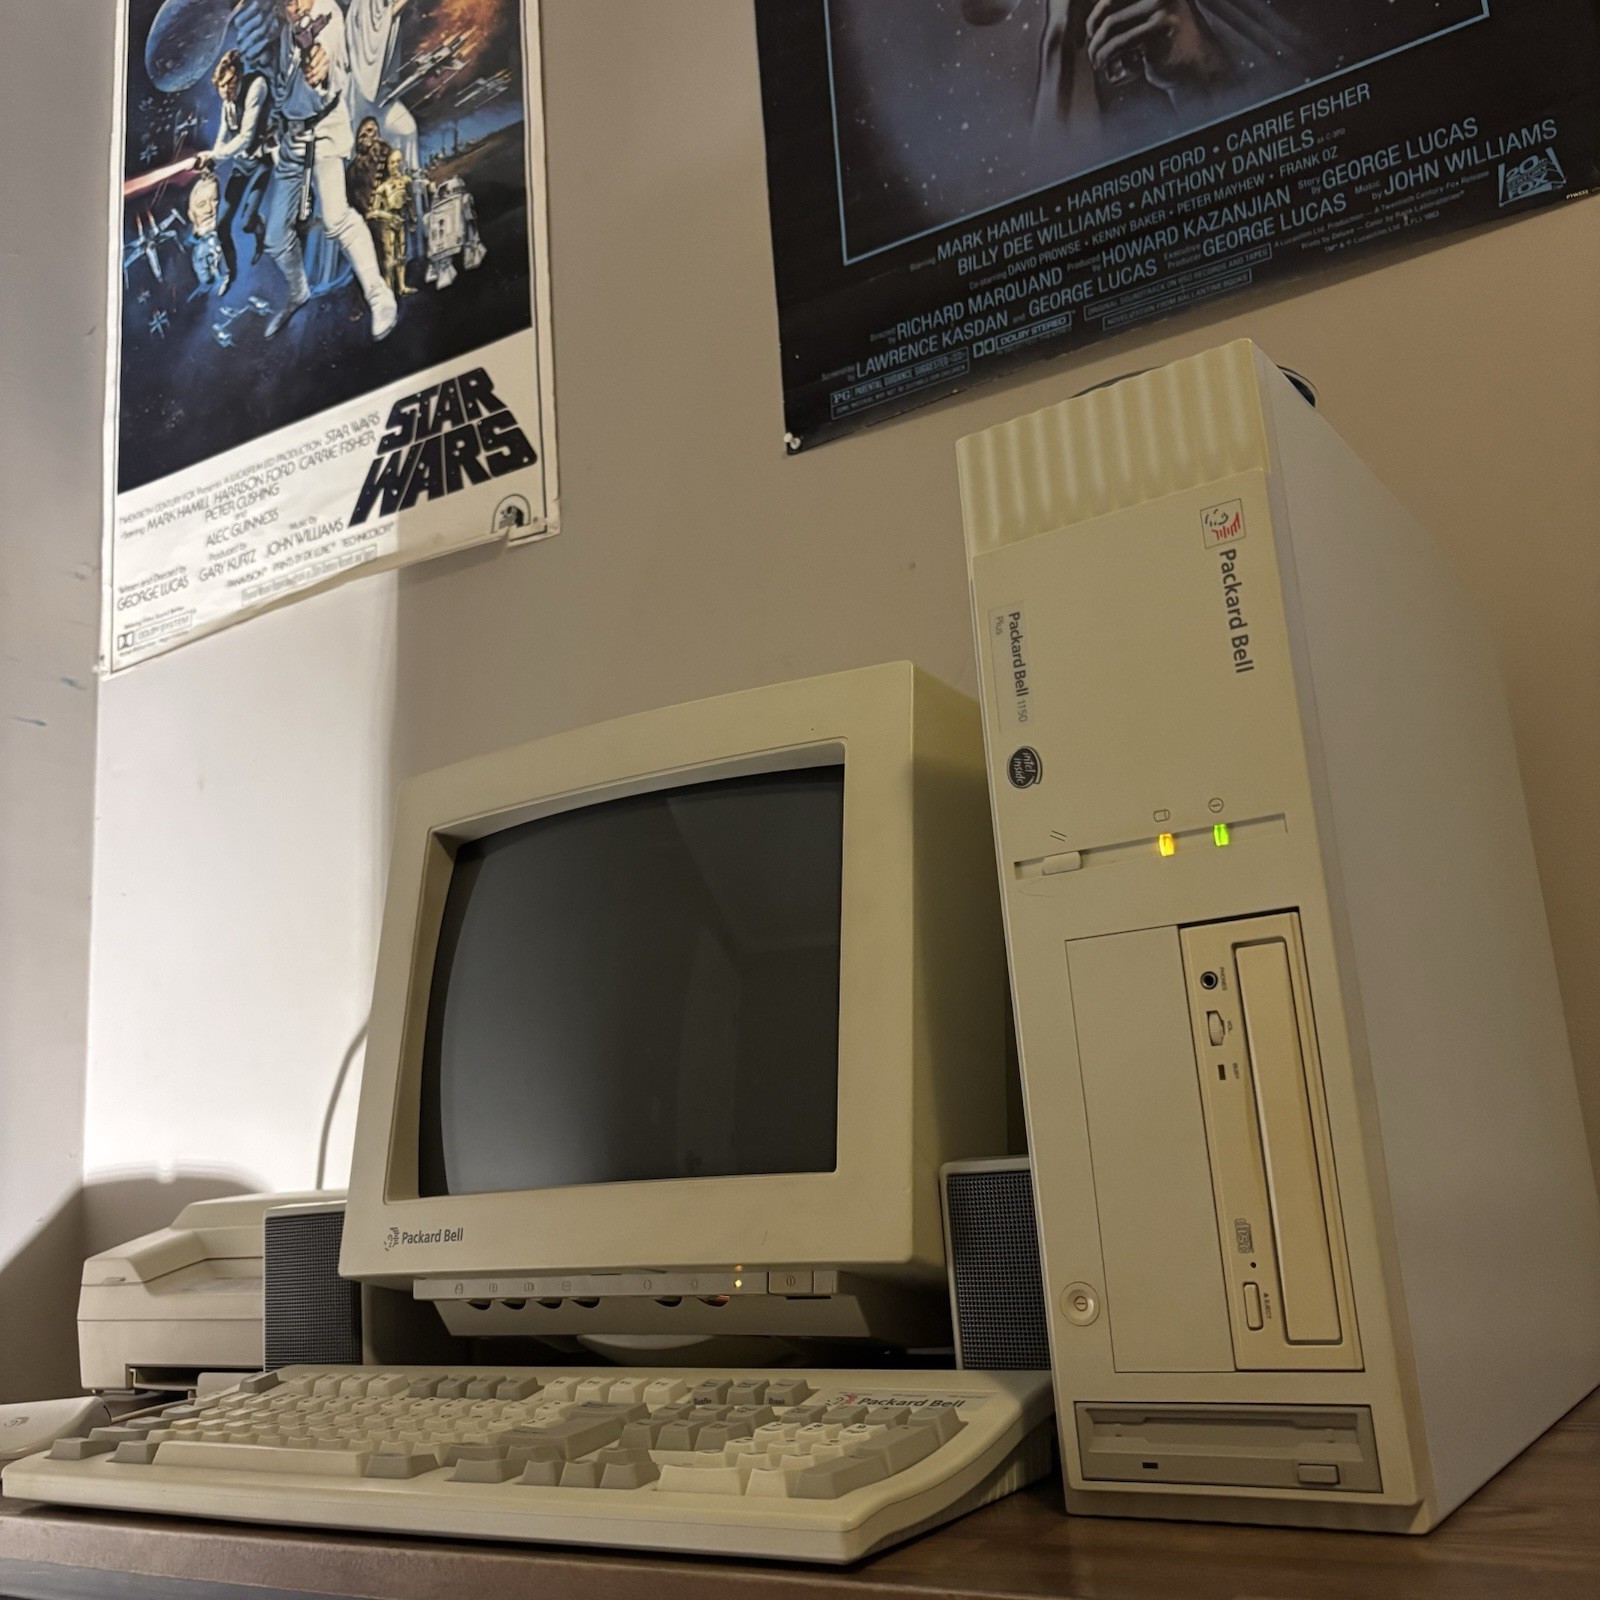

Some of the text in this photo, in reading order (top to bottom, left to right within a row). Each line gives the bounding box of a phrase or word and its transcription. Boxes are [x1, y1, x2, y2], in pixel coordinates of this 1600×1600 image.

[937, 230, 983, 261] MARK
[987, 207, 1049, 242] HAMILL
[1067, 165, 1155, 212] HARRISON
[1159, 146, 1206, 177] FORD
[1226, 111, 1295, 151] CARRIE
[1300, 83, 1370, 123] FISHER
[1509, 173, 1549, 198] FOX
[957, 246, 999, 276] BILLY
[1003, 234, 1033, 259] DEE
[1037, 201, 1123, 246] WILLIAMS
[1141, 161, 1226, 209] ANTHONY
[1232, 129, 1315, 175] DANIELS
[1008, 257, 1037, 276] DAVID
[1039, 241, 1081, 265] PROWSE
[1091, 224, 1126, 246] KENNY
[1130, 210, 1166, 231] BAKER
[1177, 195, 1211, 215] PETER
[1214, 173, 1265, 201] MAYHEW
[1279, 154, 1320, 178] FRANK
[1322, 146, 1338, 162] OZ
[856, 335, 939, 378] LAWRENCE
[942, 311, 1008, 348] KASDAN
[1029, 280, 1094, 317] GEORGE
[1098, 258, 1157, 293] LUCAS
[1202, 217, 1276, 257] GEORGE
[1280, 192, 1347, 231] LUCAS
[1354, 180, 1381, 194] Music
[1371, 191, 1383, 200] by
[1385, 159, 1440, 196] JOHN
[1444, 119, 1558, 174] WILLIAMS
[896, 302, 964, 341] RICHARD
[968, 267, 1063, 315] MARQUAND
[1101, 225, 1179, 269] HOWARD
[1183, 185, 1291, 239] KAZANJIAN
[1298, 176, 1321, 190] Story
[1311, 185, 1321, 195] by
[1322, 144, 1402, 189] GEORGE
[1406, 117, 1479, 160] LUCAS
[1000, 328, 1031, 345] DOLBY
[1031, 317, 1067, 337] STEREO
[377, 366, 507, 456] STAR
[834, 389, 851, 404] PG
[324, 424, 350, 446] STAR
[354, 411, 381, 433] WARS
[147, 512, 176, 532] MARK
[214, 475, 264, 503] HARRISON
[265, 461, 296, 484] FORD
[299, 448, 339, 471] CARRIE
[339, 430, 377, 455] FISHER
[348, 409, 538, 528] WARS
[204, 483, 280, 522] PETER CUSHING
[206, 507, 280, 548] ALEC GUINNESS
[264, 518, 344, 559] JOHN WILLIAMS
[199, 561, 227, 582] GARY
[227, 549, 257, 572] KURTZ
[117, 575, 190, 612] GEORGE LUCAS
[1219, 549, 1254, 675] Packard Bell
[995, 615, 1004, 636] Plus
[1009, 612, 1030, 723] Packard Bell 1150
[1013, 757, 1026, 784] inside
[1022, 752, 1037, 773] intel
[402, 1227, 464, 1244] Packard Bell
[857, 1397, 967, 1408] Packard Bell
